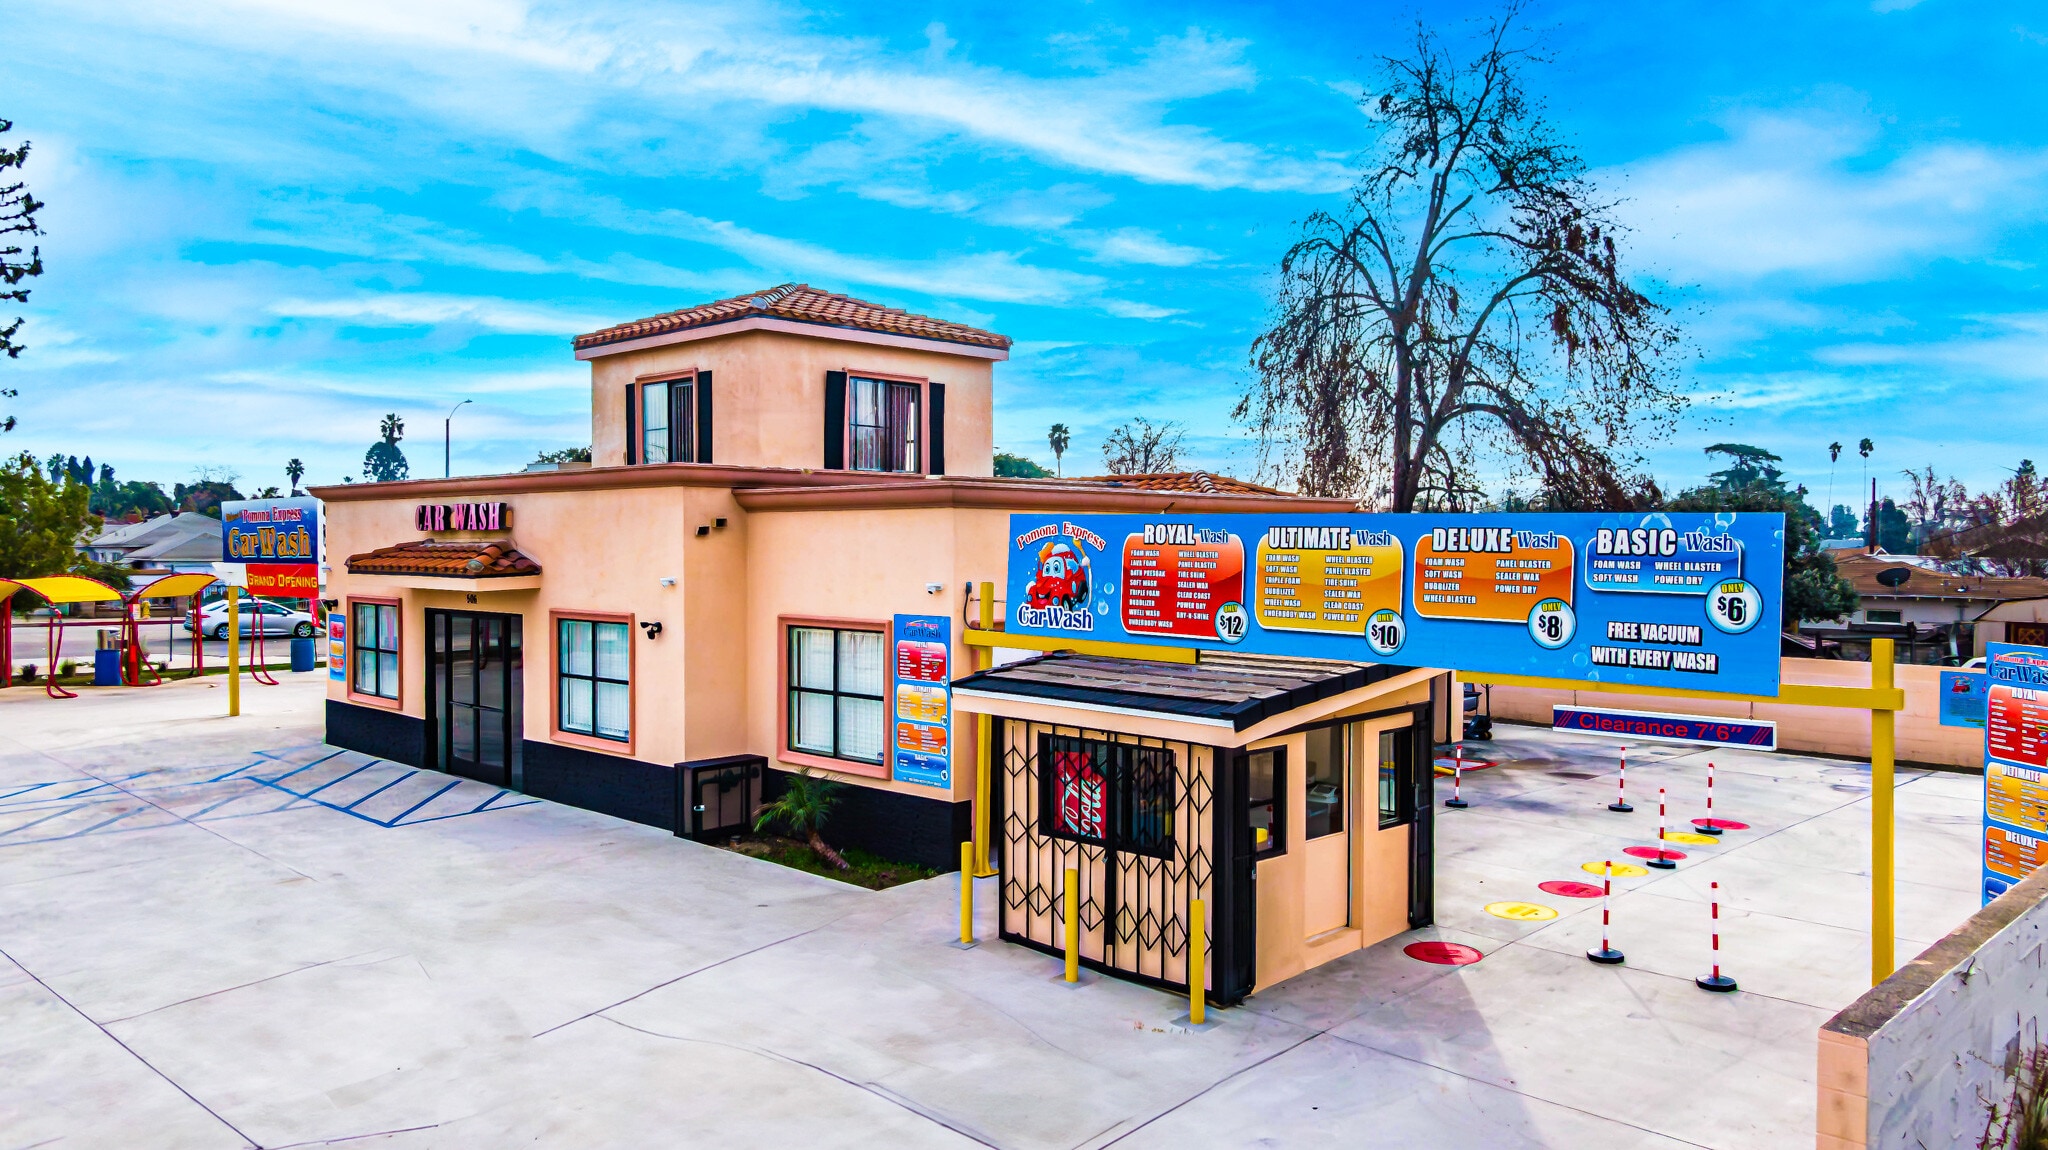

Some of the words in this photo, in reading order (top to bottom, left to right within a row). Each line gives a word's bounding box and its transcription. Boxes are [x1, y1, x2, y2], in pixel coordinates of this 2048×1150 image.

[243, 509, 270, 523] Pomona
[272, 506, 302, 525] Express
[415, 505, 445, 531] CAR
[453, 502, 500, 530] WASH
[1016, 524, 1058, 550] Pomona
[1062, 522, 1106, 551] Express
[1144, 524, 1196, 545] ROYAL
[1199, 528, 1229, 544] Wash
[1268, 526, 1351, 550] ULTIMATE
[1356, 529, 1392, 546] Wash
[1432, 527, 1512, 553] DELUXE
[1516, 530, 1559, 549] Wash
[1596, 528, 1677, 556] BASIC
[1684, 532, 1733, 552] Wash
[1196, 551, 1219, 559] BLASTER
[1265, 554, 1281, 562] FOAM
[1282, 554, 1300, 562] WASH
[1325, 555, 1345, 563] WHEEL
[1346, 556, 1373, 564] BLASTER
[1194, 561, 1217, 569] BLASTER
[1425, 558, 1443, 566] FOAM
[1445, 558, 1465, 566] WASH
[1496, 559, 1517, 568] PANEL
[1519, 560, 1551, 569] BLASTER
[1593, 560, 1615, 569] FOAM
[1617, 560, 1641, 570] WASH
[1655, 562, 1682, 571] WHEEL
[1684, 562, 1721, 572] BLASTER
[1265, 565, 1279, 573] SOFT
[1280, 565, 1298, 574] WASH
[1325, 567, 1342, 575] PANEL
[1344, 568, 1371, 576] BLASTER
[1424, 570, 1440, 578] SOFT
[1442, 570, 1462, 578] WASH
[248, 573, 275, 586] GRAND
[278, 574, 317, 587] OPENING
[1265, 576, 1284, 584] TRIPLE
[1284, 577, 1301, 585] FOAM
[1496, 572, 1520, 580] SEALER
[1522, 573, 1540, 581] WAX
[1593, 574, 1612, 582] SOFT
[1614, 574, 1638, 583] WASH
[1654, 575, 1684, 585] POWER
[1686, 576, 1703, 585] DRY
[1324, 578, 1338, 586] TIRE
[1339, 579, 1358, 587] SHINE
[1495, 584, 1520, 593] POWER
[1522, 585, 1537, 594] DRY
[1721, 583, 1744, 593] ONLY
[1324, 590, 1345, 598] SEALER
[1347, 591, 1361, 599] WAX
[1423, 594, 1445, 602] WHEEL
[1446, 595, 1476, 604] BLASTER
[1176, 601, 1194, 609] POWER
[1264, 598, 1282, 606] WHEEL
[1283, 599, 1301, 607] WASH
[1324, 601, 1342, 609] CLEAR
[1542, 602, 1561, 611] ONLY
[1223, 605, 1238, 613] ONLY
[1717, 596, 1746, 624] $6
[1298, 611, 1316, 620] WASH
[1323, 613, 1344, 621] POWER
[1346, 614, 1358, 622] DRY
[1377, 614, 1393, 622] ONLY
[1220, 615, 1243, 637] $12
[1538, 614, 1562, 641] $8
[1371, 624, 1400, 649] $10
[1608, 622, 1638, 640] FREE
[1640, 623, 1702, 645] VACUUM
[1591, 646, 1627, 665] WITH
[1629, 648, 1671, 670] EVERY
[1673, 652, 1718, 673] WASH
[2026, 657, 2048, 667] Expr
[1989, 662, 2048, 684] CarWas
[2011, 688, 2037, 701] ROYAL
[1579, 713, 1688, 737] Clearance
[1695, 723, 1743, 741] 7'6"
[2001, 764, 2040, 782] ULTIMATE
[2005, 830, 2038, 849] DELUXE
